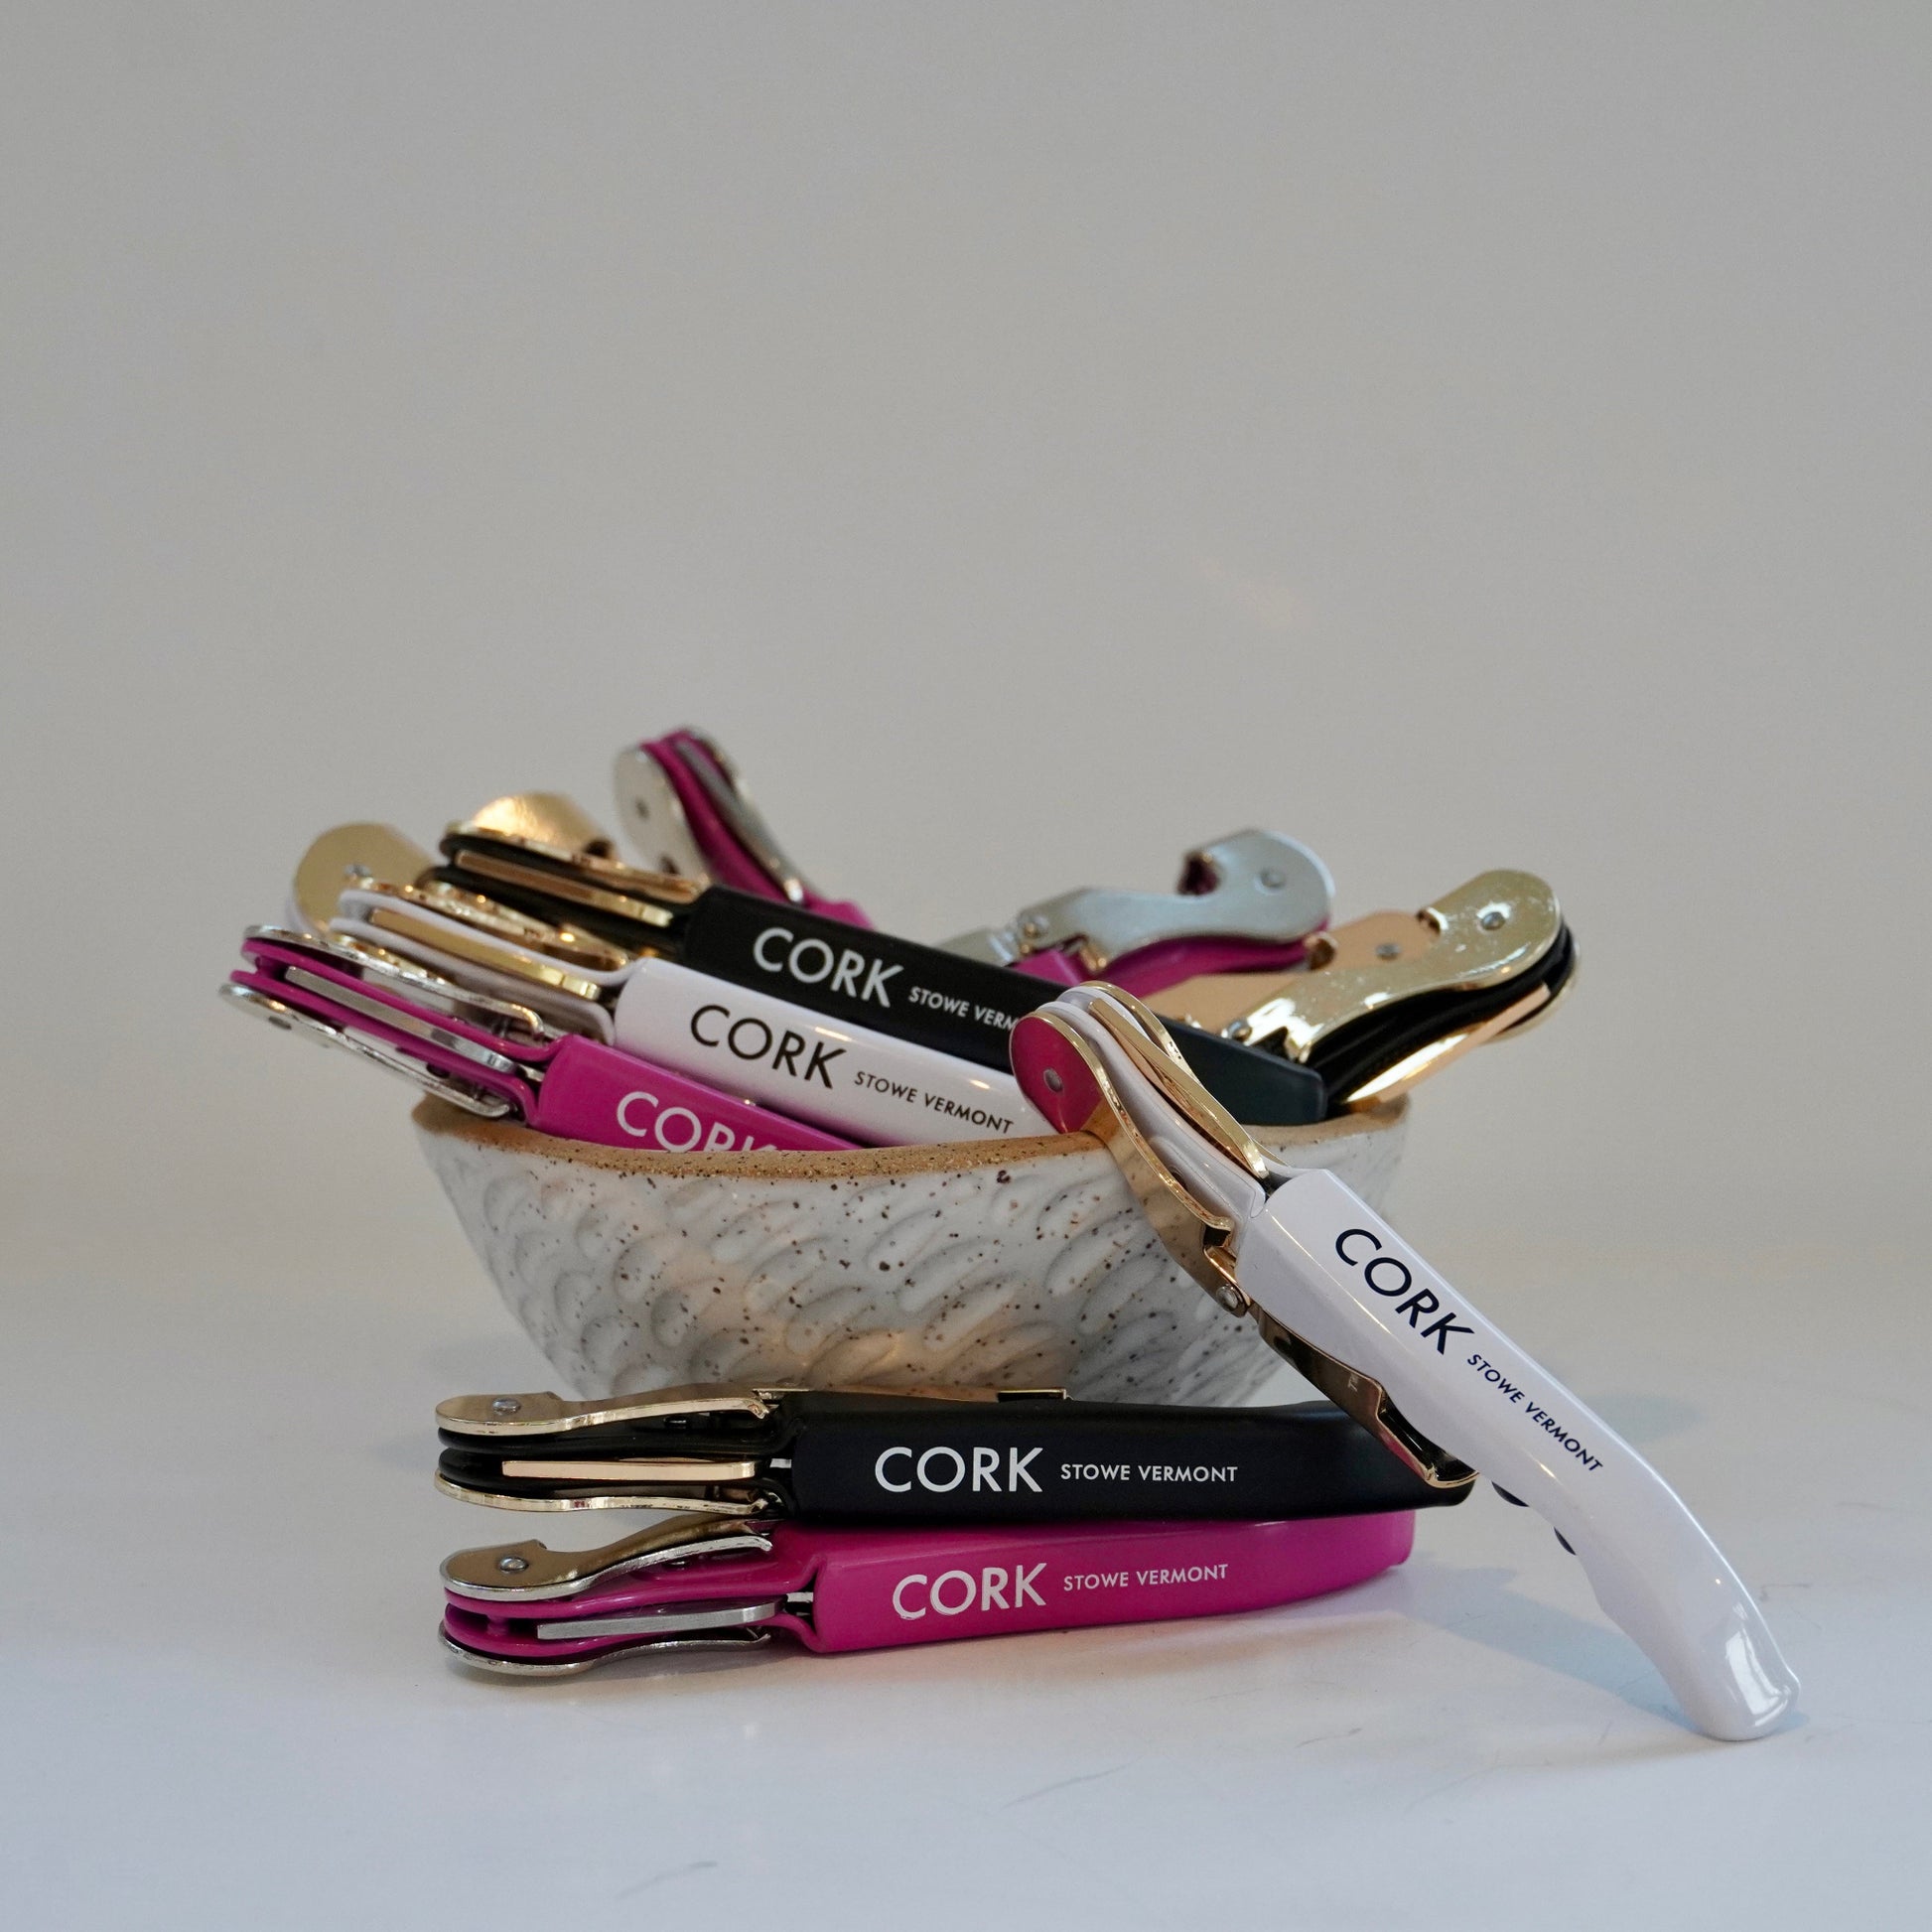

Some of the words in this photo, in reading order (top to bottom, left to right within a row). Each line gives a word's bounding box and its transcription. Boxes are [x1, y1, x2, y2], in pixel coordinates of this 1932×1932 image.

[753, 927, 904, 1008] CORK
[907, 986, 969, 1019] STOWE
[974, 1004, 1020, 1032] VERM
[690, 1005, 847, 1089] CORK
[854, 1070, 918, 1103] STOWE
[923, 1094, 1015, 1135] VERMONT
[1334, 1228, 1475, 1355] CORK
[1466, 1353, 1526, 1405] STOWE
[1524, 1401, 1603, 1472] VERMONT
[875, 1447, 1043, 1493] CORK
[1060, 1463, 1131, 1481] STOWE
[1138, 1464, 1238, 1482] VERMONT
[893, 1562, 1047, 1620] CORK
[1063, 1572, 1130, 1591] STOWE
[1136, 1564, 1229, 1586] VERMONT
